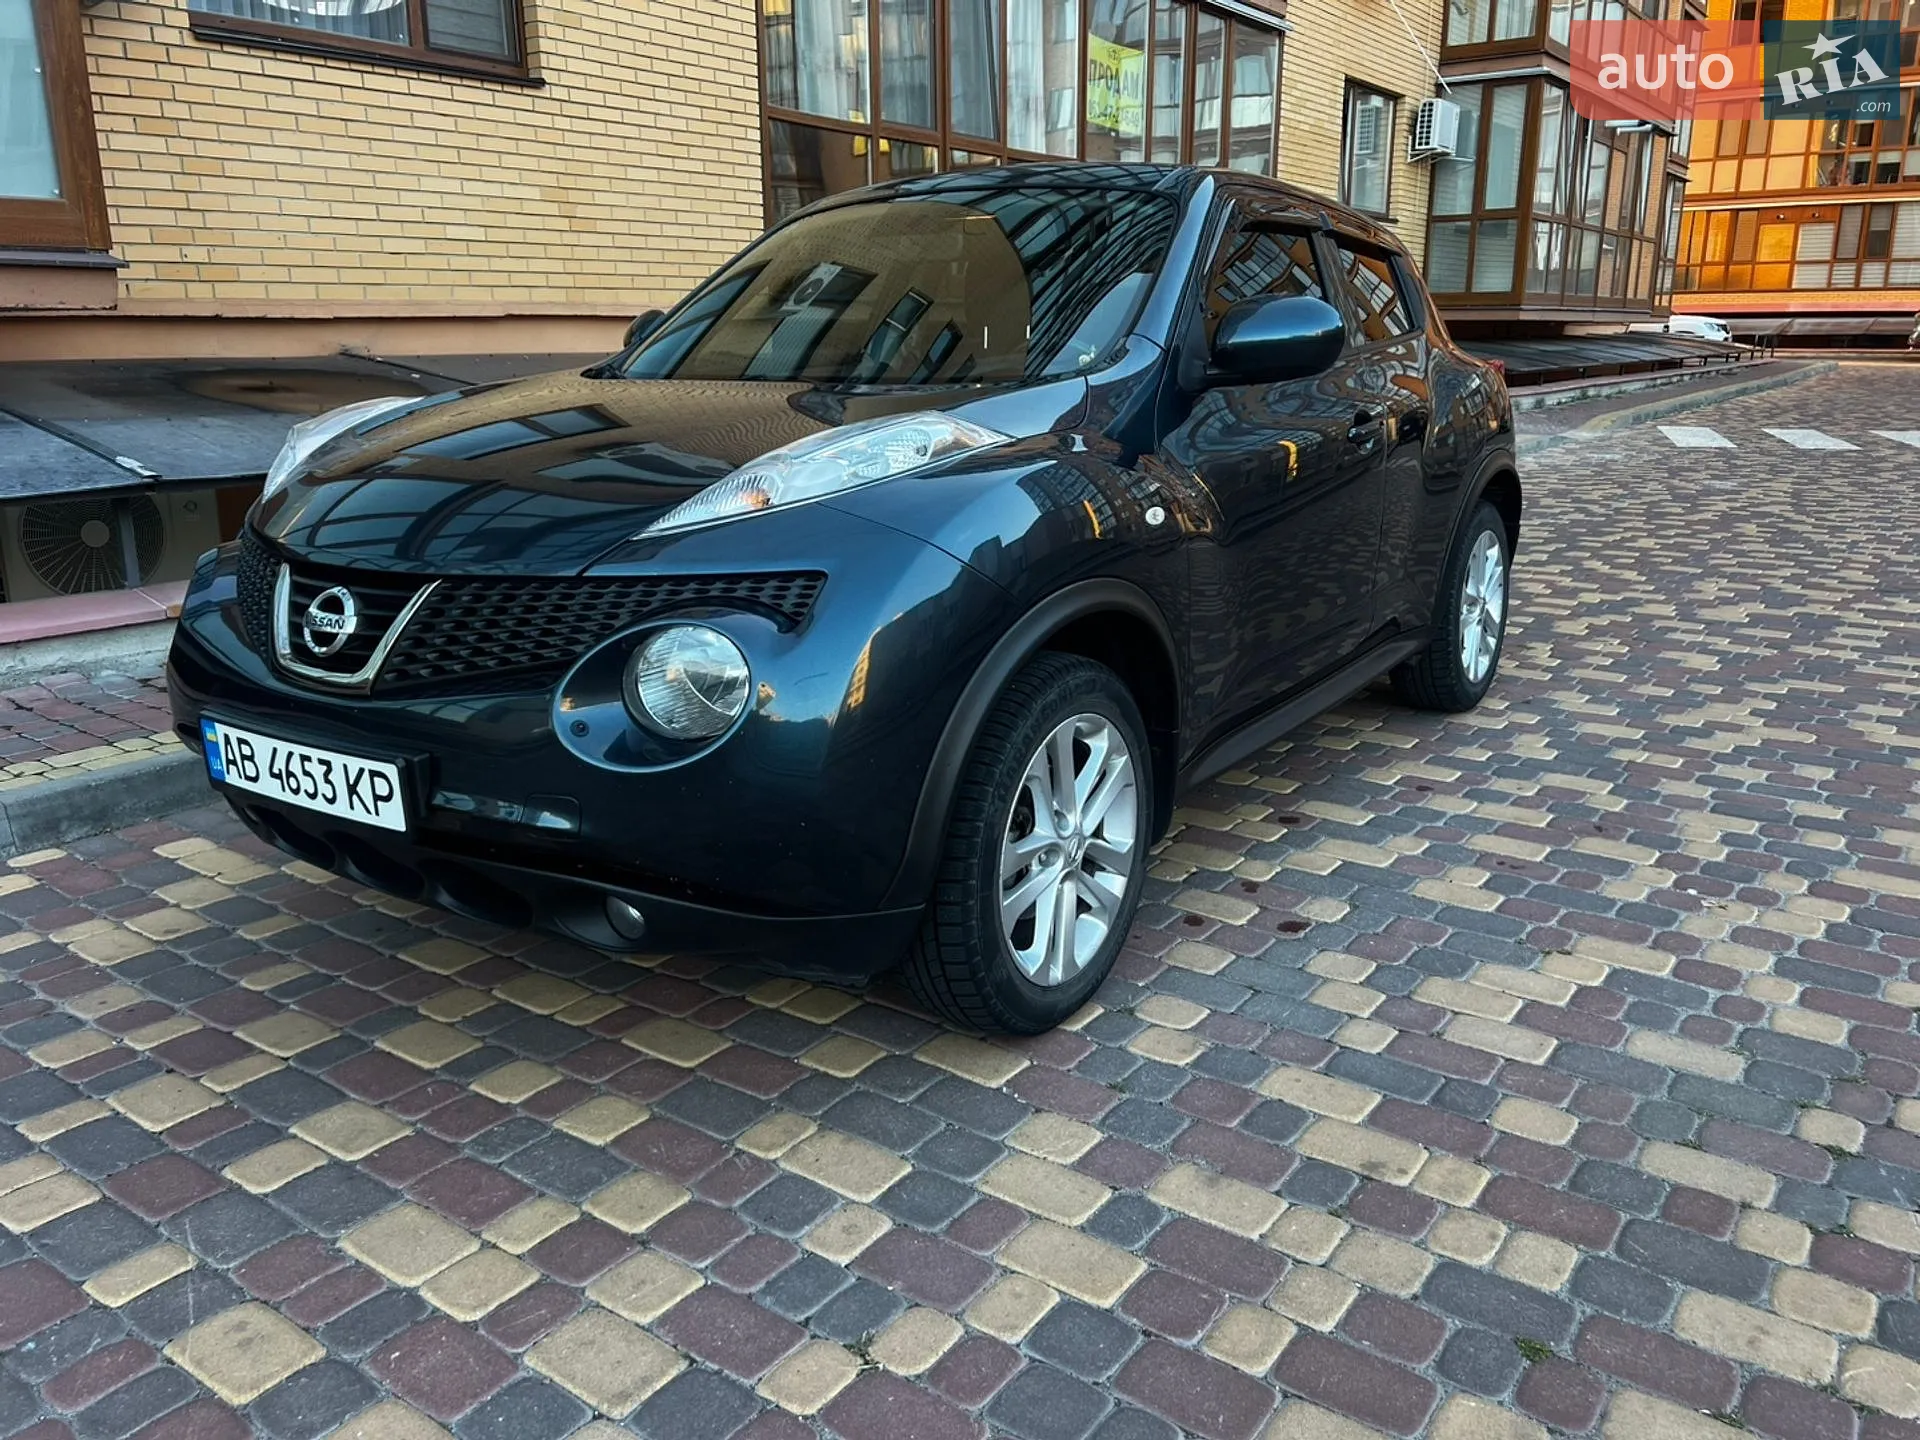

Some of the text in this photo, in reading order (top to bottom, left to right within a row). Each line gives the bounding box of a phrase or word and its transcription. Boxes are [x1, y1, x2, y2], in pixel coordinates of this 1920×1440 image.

[1088, 59, 1140, 100] ПРОДАМ
[307, 614, 345, 630] ISSAN
[223, 732, 395, 817] AB 4653 KP
